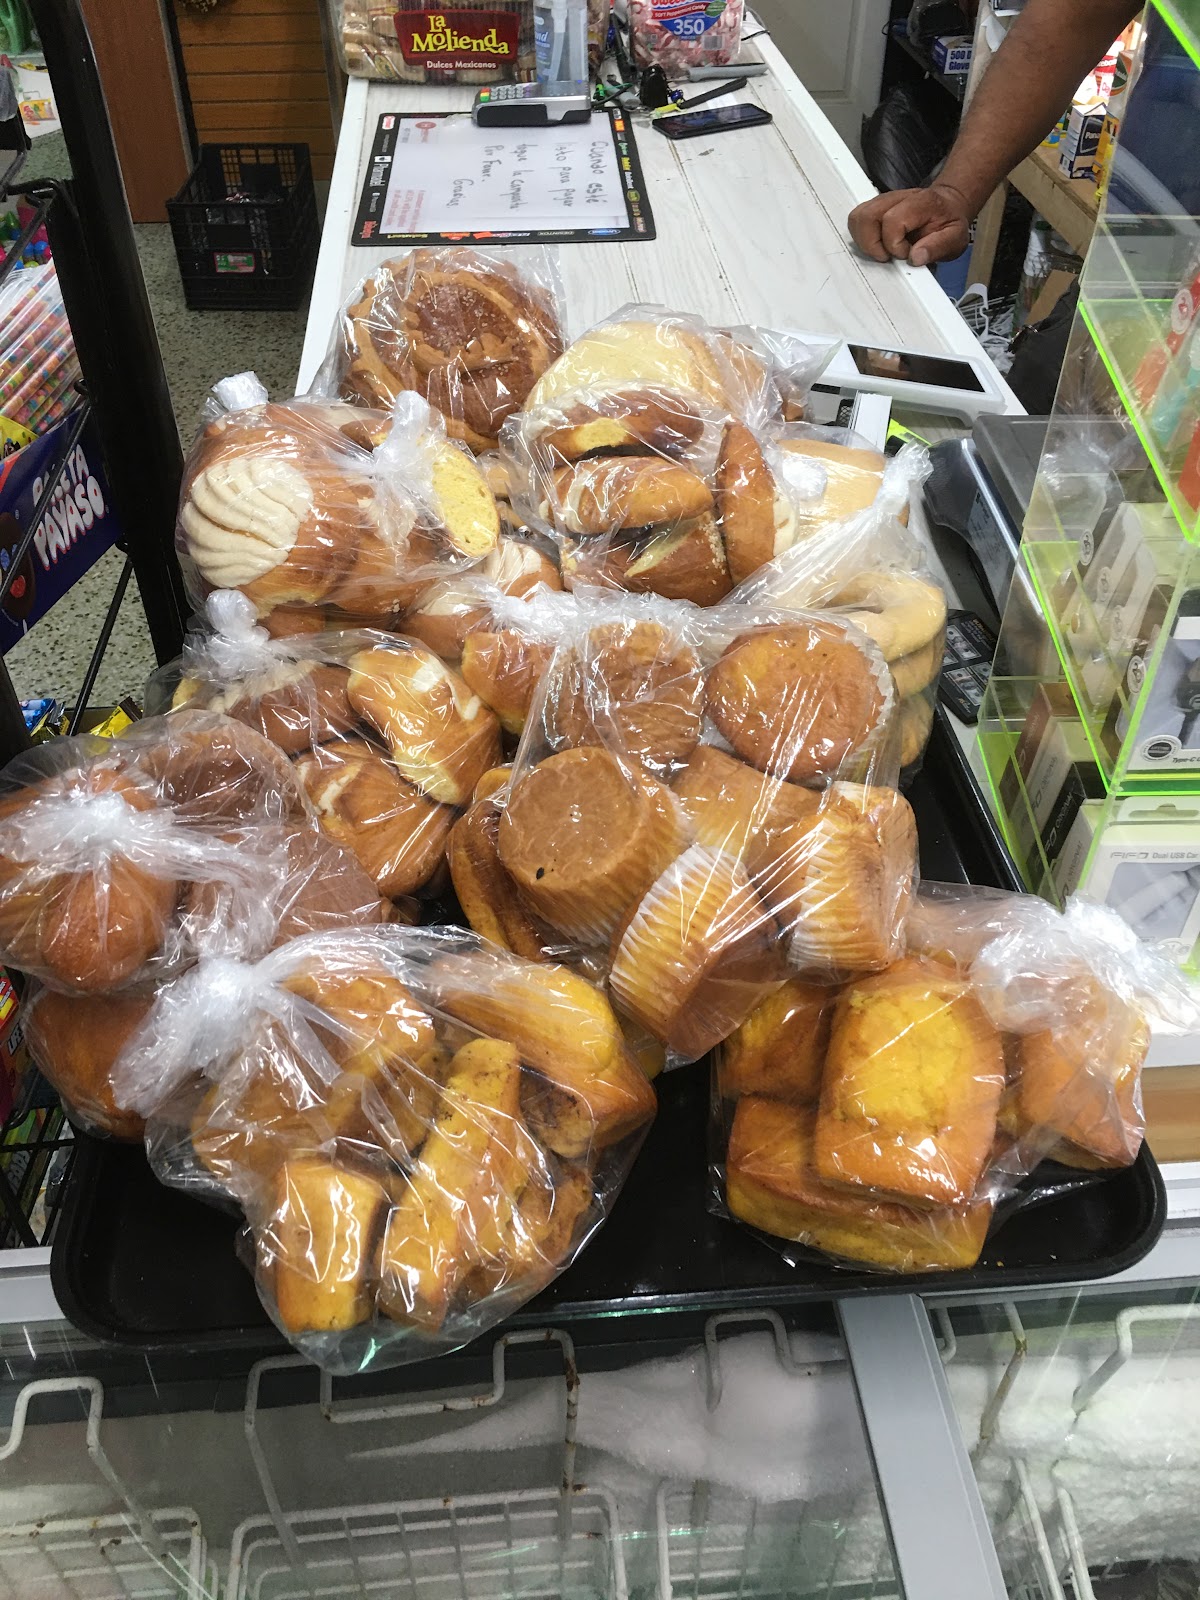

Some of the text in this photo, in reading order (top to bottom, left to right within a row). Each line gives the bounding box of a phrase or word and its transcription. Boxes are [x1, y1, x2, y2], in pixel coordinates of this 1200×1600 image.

[692, 4, 706, 12] Candy
[427, 15, 446, 32] La
[673, 19, 705, 35] 350
[411, 29, 510, 54] Molienda
[950, 51, 966, 59] 500
[426, 60, 496, 69] Dulces Mexicanos
[588, 141, 609, 175] Cuando
[547, 166, 573, 184] para
[547, 188, 577, 207] pagar
[34, 475, 105, 571] PAYASO
